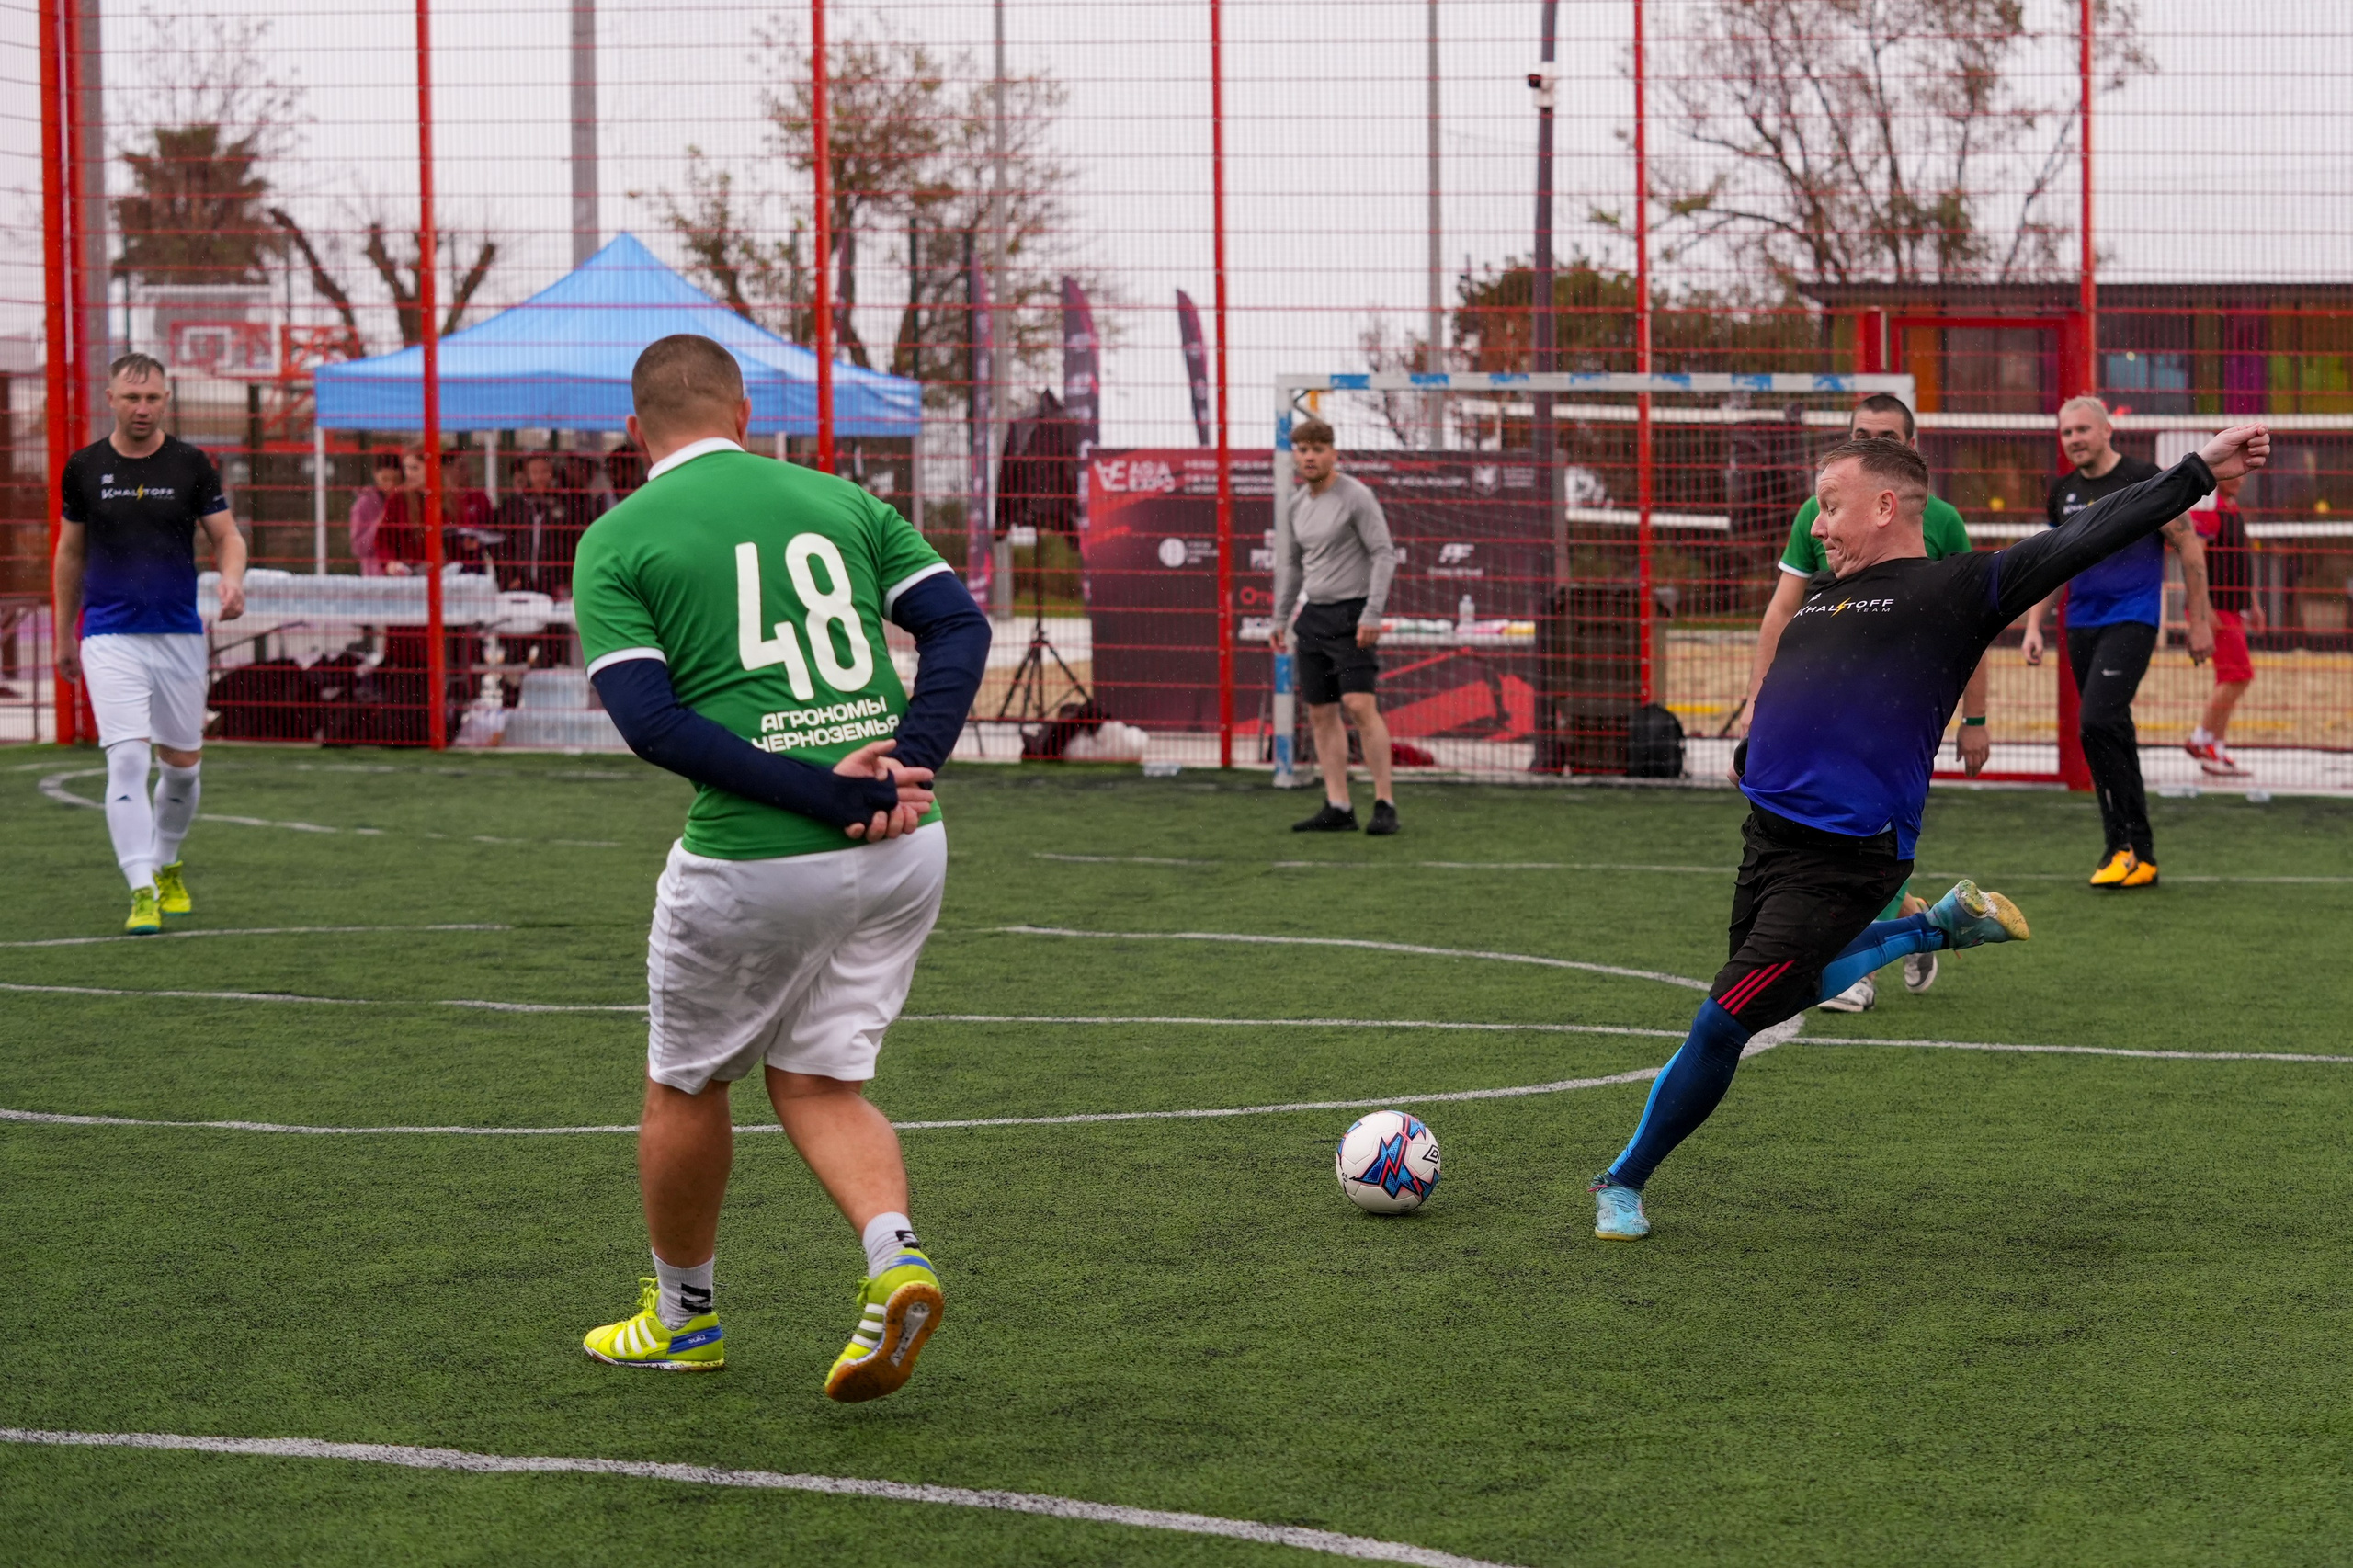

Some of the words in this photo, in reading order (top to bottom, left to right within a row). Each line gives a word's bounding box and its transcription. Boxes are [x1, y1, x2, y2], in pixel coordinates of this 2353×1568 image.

[735, 532, 874, 701] 48
[760, 696, 888, 733] АГРОНОМЫ
[752, 715, 900, 753] ЧЕРНОЗЕМЬЯ
